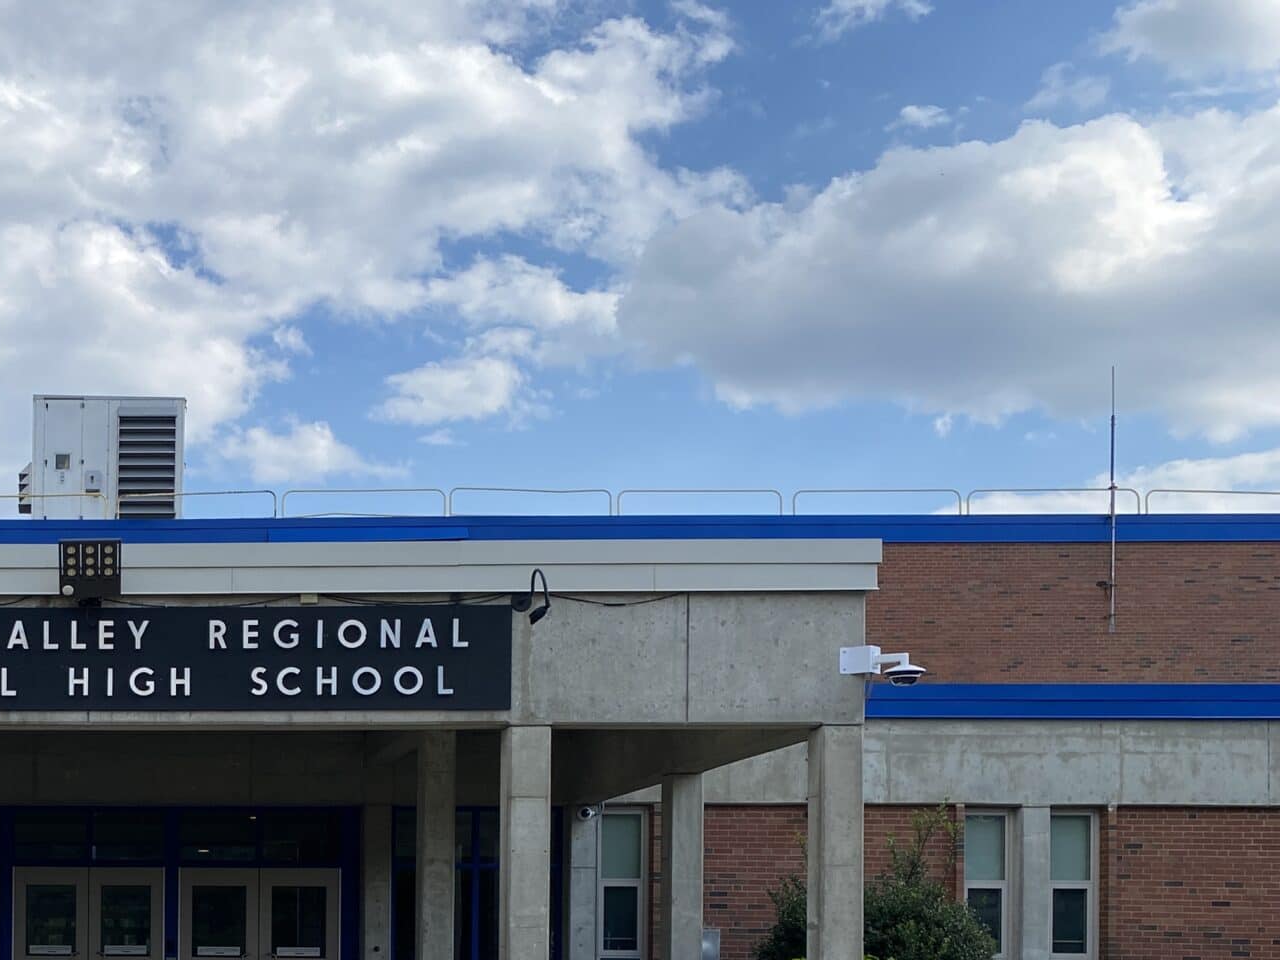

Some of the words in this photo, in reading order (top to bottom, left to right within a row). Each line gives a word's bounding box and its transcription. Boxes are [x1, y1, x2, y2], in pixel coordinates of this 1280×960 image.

[209, 618, 470, 650] REGIONAL
[68, 666, 192, 697] HIGH
[250, 665, 455, 697] SCHOOL
